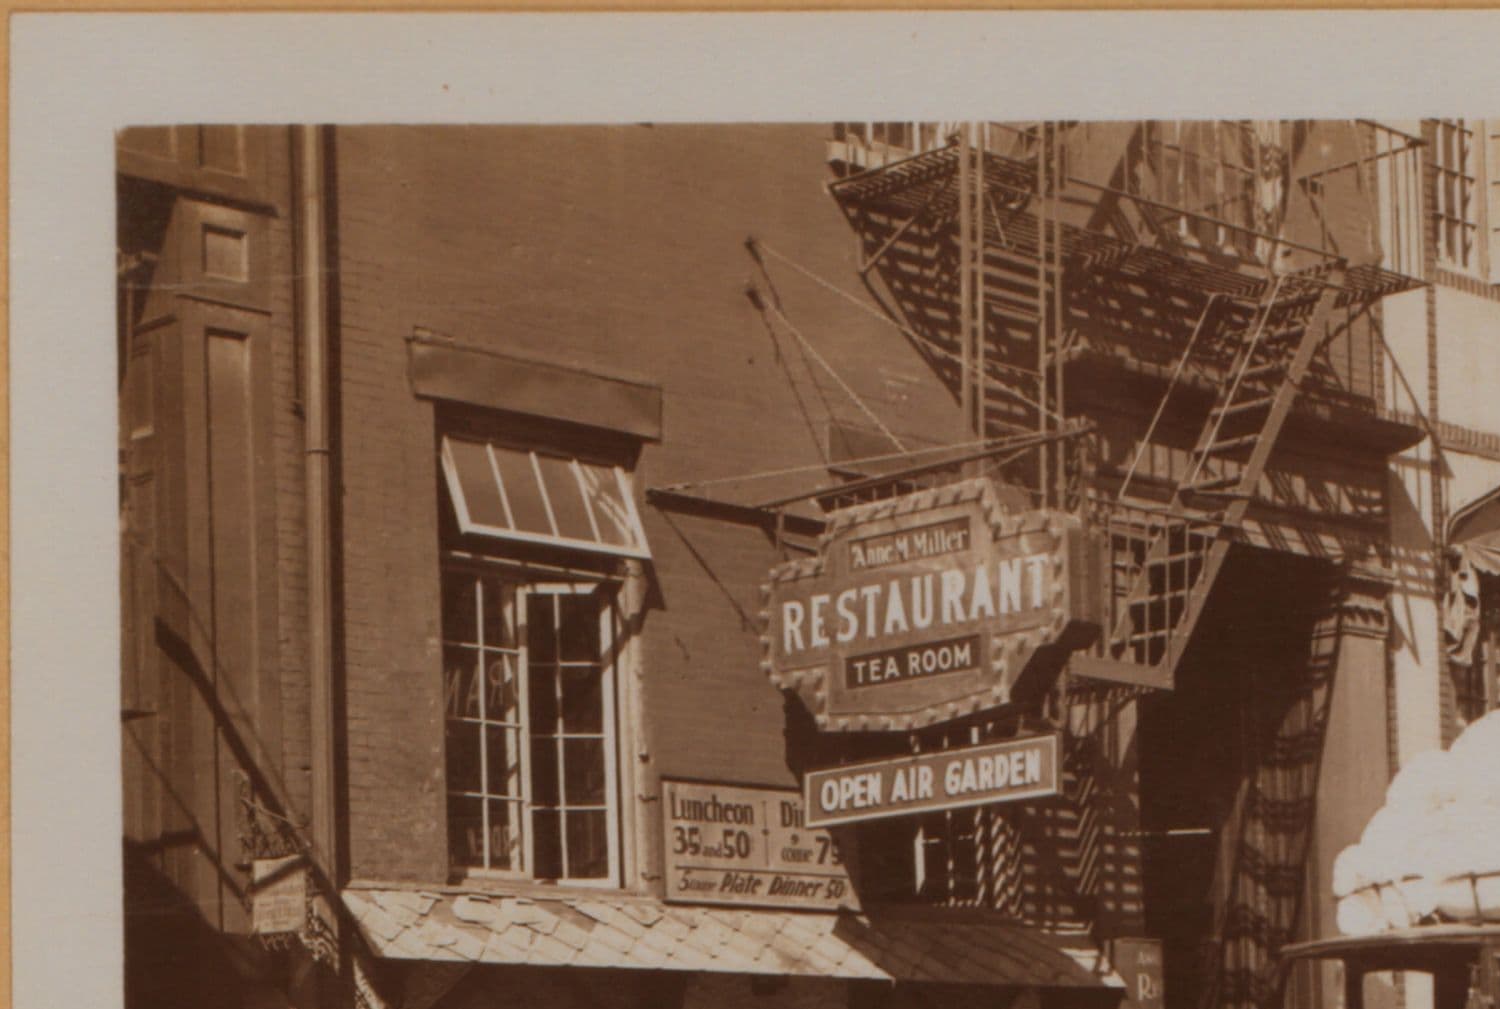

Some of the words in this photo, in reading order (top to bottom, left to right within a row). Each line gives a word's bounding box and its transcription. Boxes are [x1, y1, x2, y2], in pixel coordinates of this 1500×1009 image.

[912, 527, 968, 556] Miller
[783, 553, 1048, 655] RESTAURANT
[854, 656, 900, 684] TEA
[908, 642, 972, 675] ROOM
[821, 772, 883, 811] OPEN
[890, 765, 934, 803] AIR
[944, 749, 1041, 795] GARDEN
[670, 791, 754, 825] Luncheon
[673, 827, 700, 856] 35
[722, 829, 751, 859] 50
[719, 871, 763, 895] Plate
[767, 875, 821, 898] Dinner
